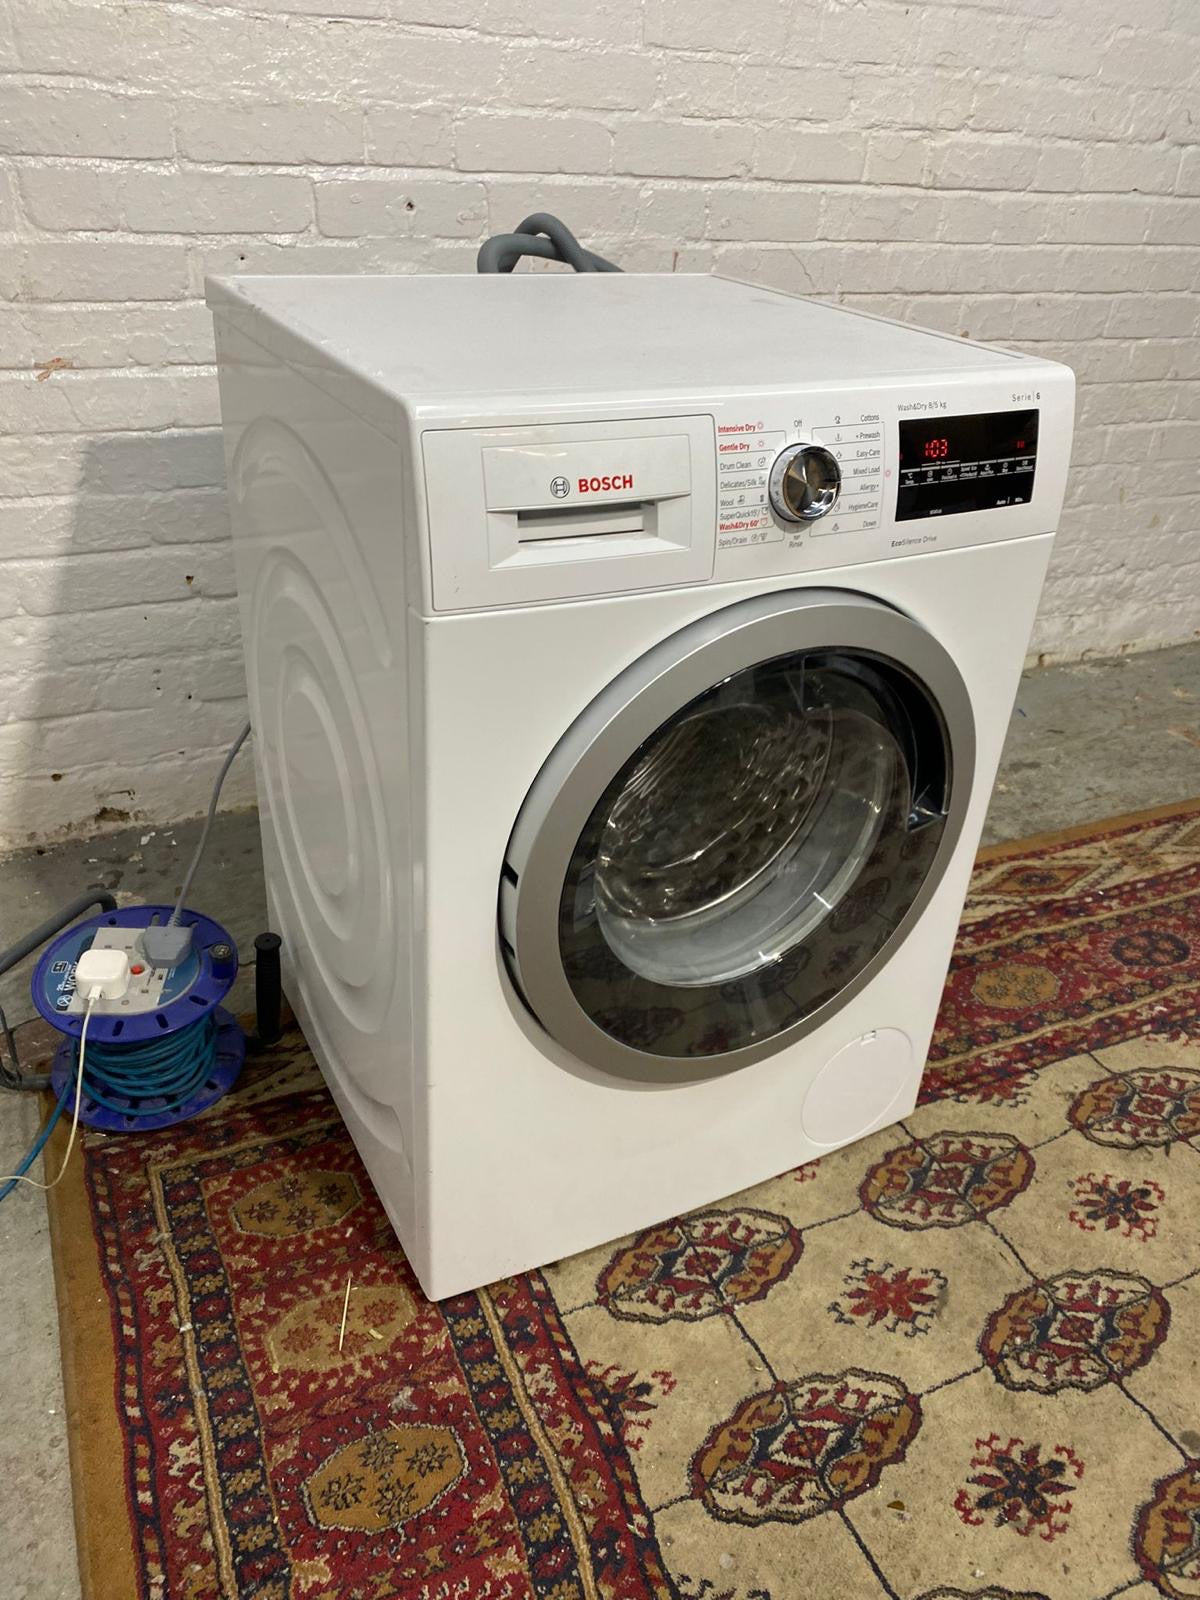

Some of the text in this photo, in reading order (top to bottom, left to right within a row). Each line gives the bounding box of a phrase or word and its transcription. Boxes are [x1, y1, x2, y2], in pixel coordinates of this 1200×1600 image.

[1012, 392, 1041, 402] Serie 6
[897, 402, 927, 411] Wash&Dry
[940, 401, 947, 410] kg
[860, 414, 880, 422] Cottons
[718, 424, 756, 433] Intensive Dry
[860, 431, 880, 439] Prewash
[719, 443, 750, 452] Gentle Dry
[720, 461, 752, 470] Drum Clean
[853, 466, 880, 475] Mixed Load
[578, 475, 633, 493] BOSCH
[720, 480, 757, 489] Delicates/Silk
[720, 499, 734, 507] Wool
[720, 521, 749, 531] Wash&Dry
[863, 520, 876, 528] Down
[718, 537, 747, 547] Spin/Drain
[789, 540, 803, 548] Rinse
[891, 535, 937, 547] EcoSilence Drive
